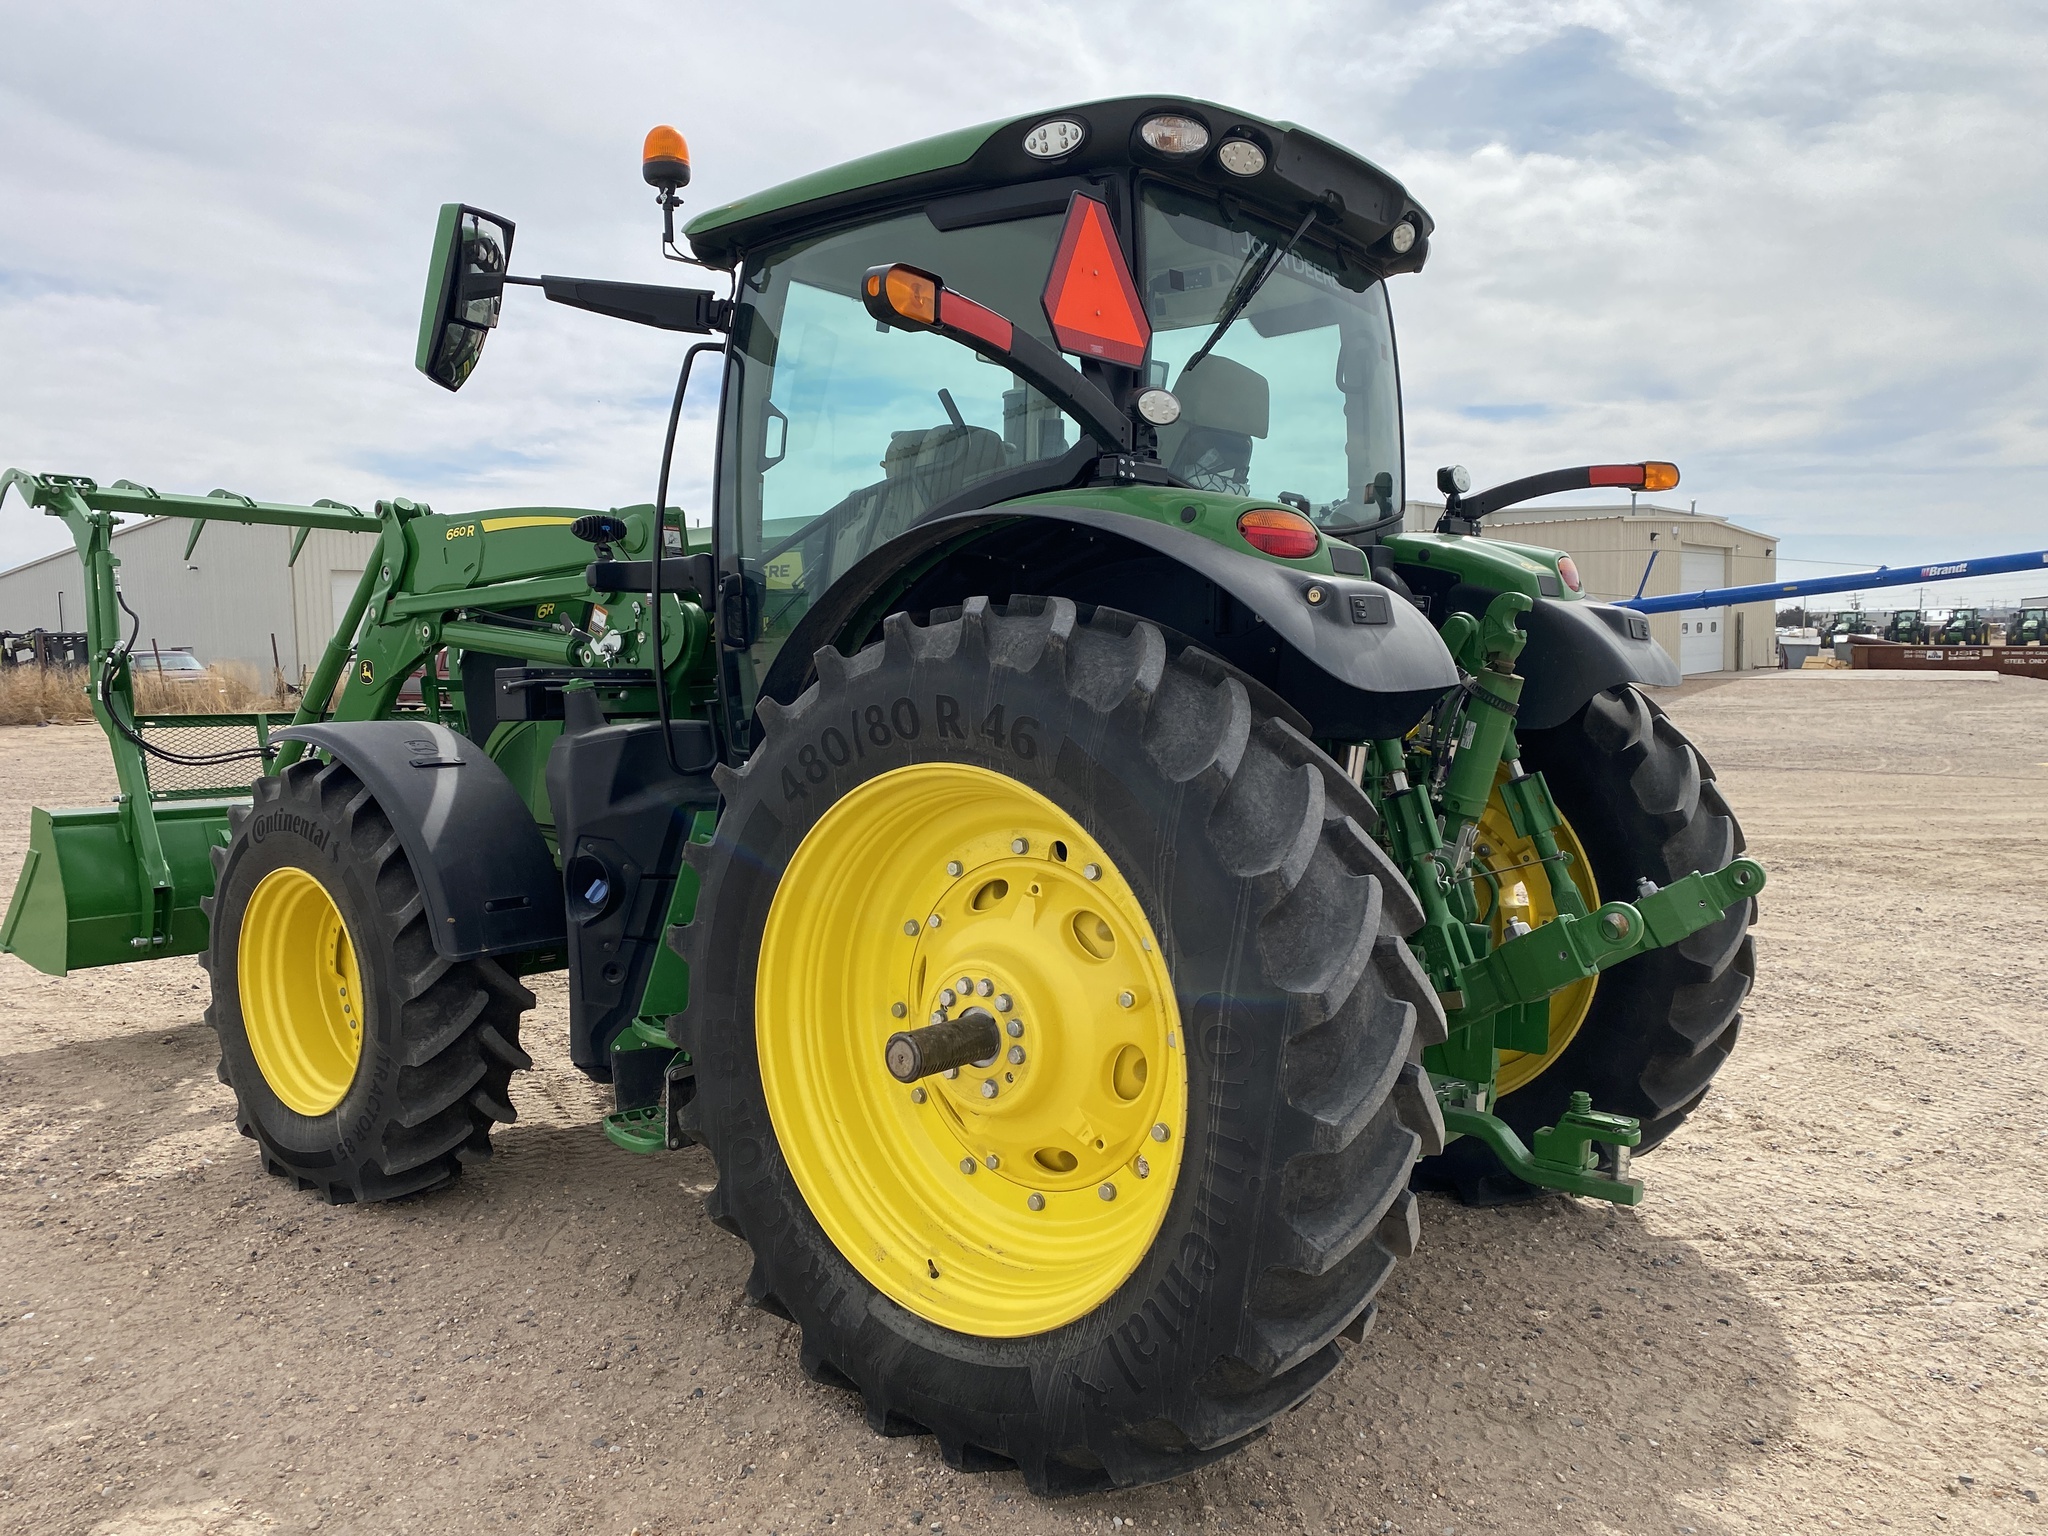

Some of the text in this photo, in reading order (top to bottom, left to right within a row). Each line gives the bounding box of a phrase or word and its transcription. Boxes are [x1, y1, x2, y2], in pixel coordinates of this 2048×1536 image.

[1241, 230, 1289, 269] JON
[537, 603, 555, 618] 6R
[780, 693, 1039, 801] 480/80 R 46
[252, 807, 331, 853] Continental
[353, 1055, 391, 1143] TRACTOR
